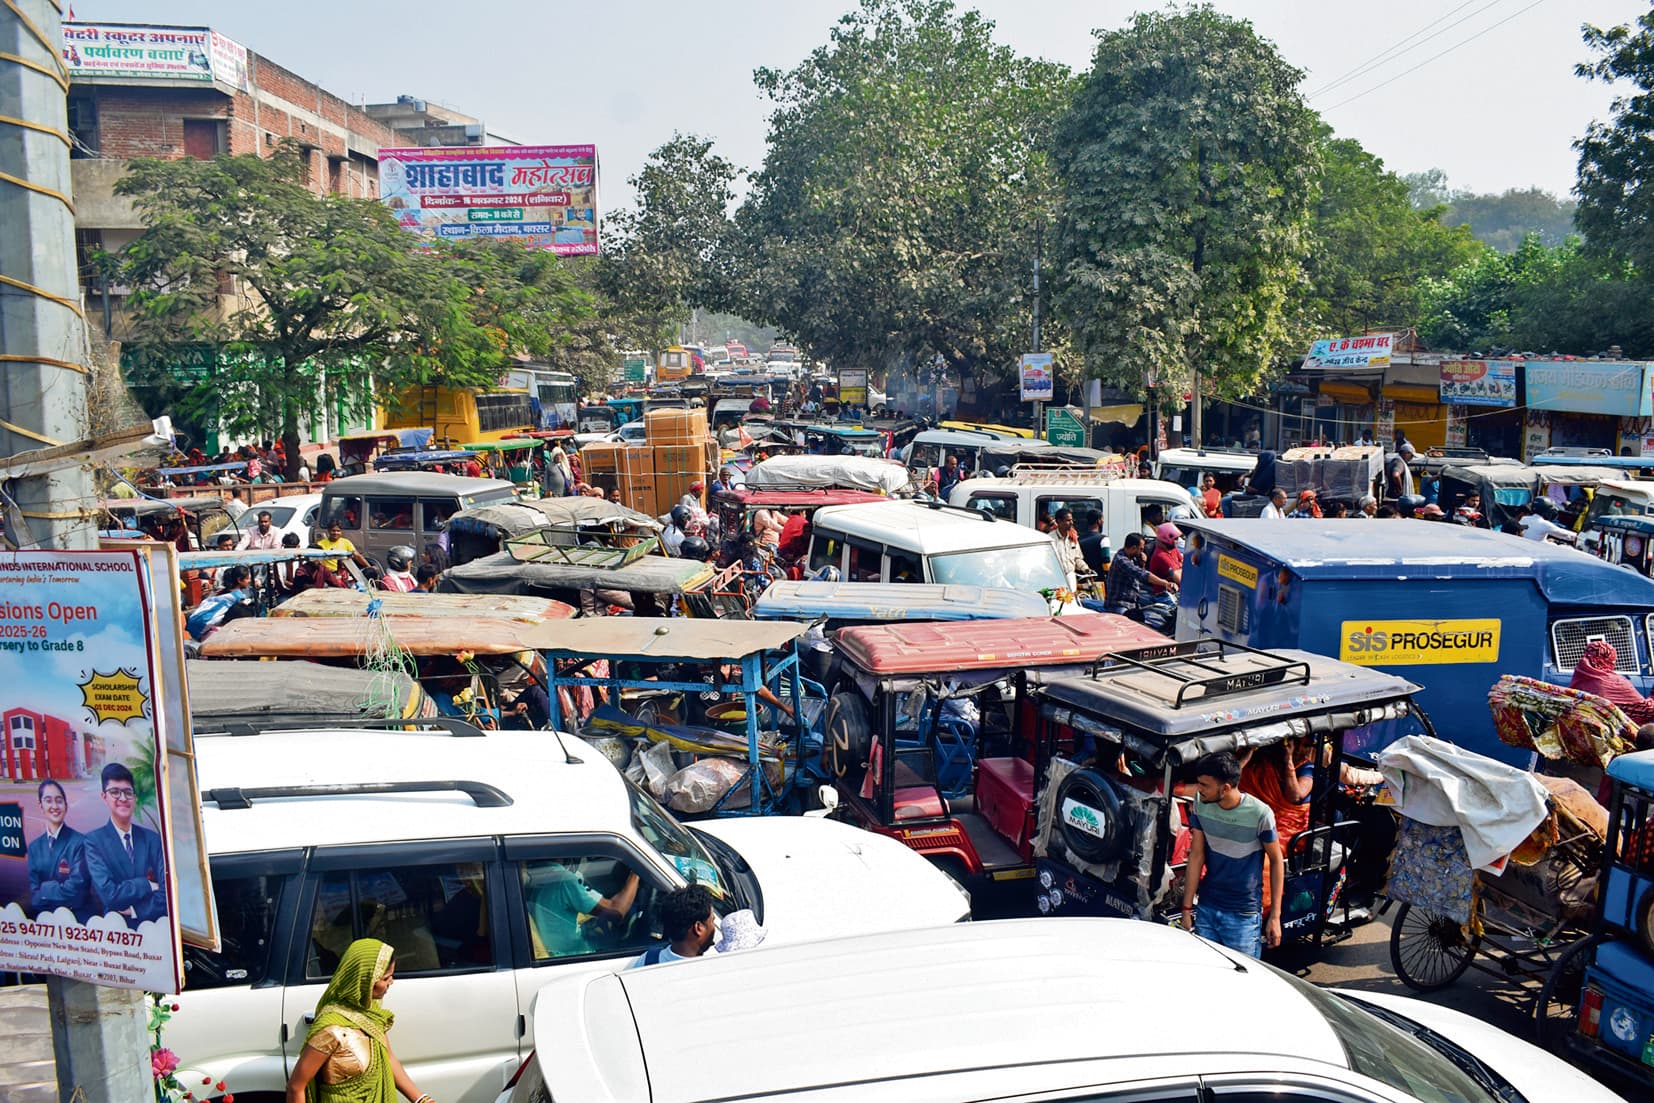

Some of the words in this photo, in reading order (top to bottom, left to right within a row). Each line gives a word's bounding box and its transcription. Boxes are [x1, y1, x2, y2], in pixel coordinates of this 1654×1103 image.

[84, 44, 143, 60] पर्यावरण
[405, 162, 506, 188] शाहाबाद
[511, 159, 592, 187] महोत्सव
[505, 196, 522, 204] 2024
[22, 562, 94, 572] INTERNATIONAL
[95, 562, 134, 572] SCHOOL
[48, 574, 81, 583] Tomorrow
[47, 602, 97, 624] Open
[0, 625, 48, 639] 2025-26
[27, 640, 39, 652] to
[41, 639, 74, 652] Grade
[76, 641, 84, 652] 8
[1390, 631, 1493, 651] PROSEGUR
[91, 683, 136, 691] SCHOLARSHIP
[94, 693, 112, 701] EXAM
[113, 694, 131, 702] DATE
[1247, 704, 1281, 716] MAYURI
[1069, 816, 1100, 836] MAYURI
[2, 835, 20, 849] ON
[1105, 894, 1135, 916] MAYURI
[0, 921, 17, 934] 25
[19, 922, 55, 938] 94777
[65, 926, 104, 943] 92347
[107, 931, 143, 947] 47877
[143, 952, 163, 961] Buxar
[122, 963, 146, 975] Railway
